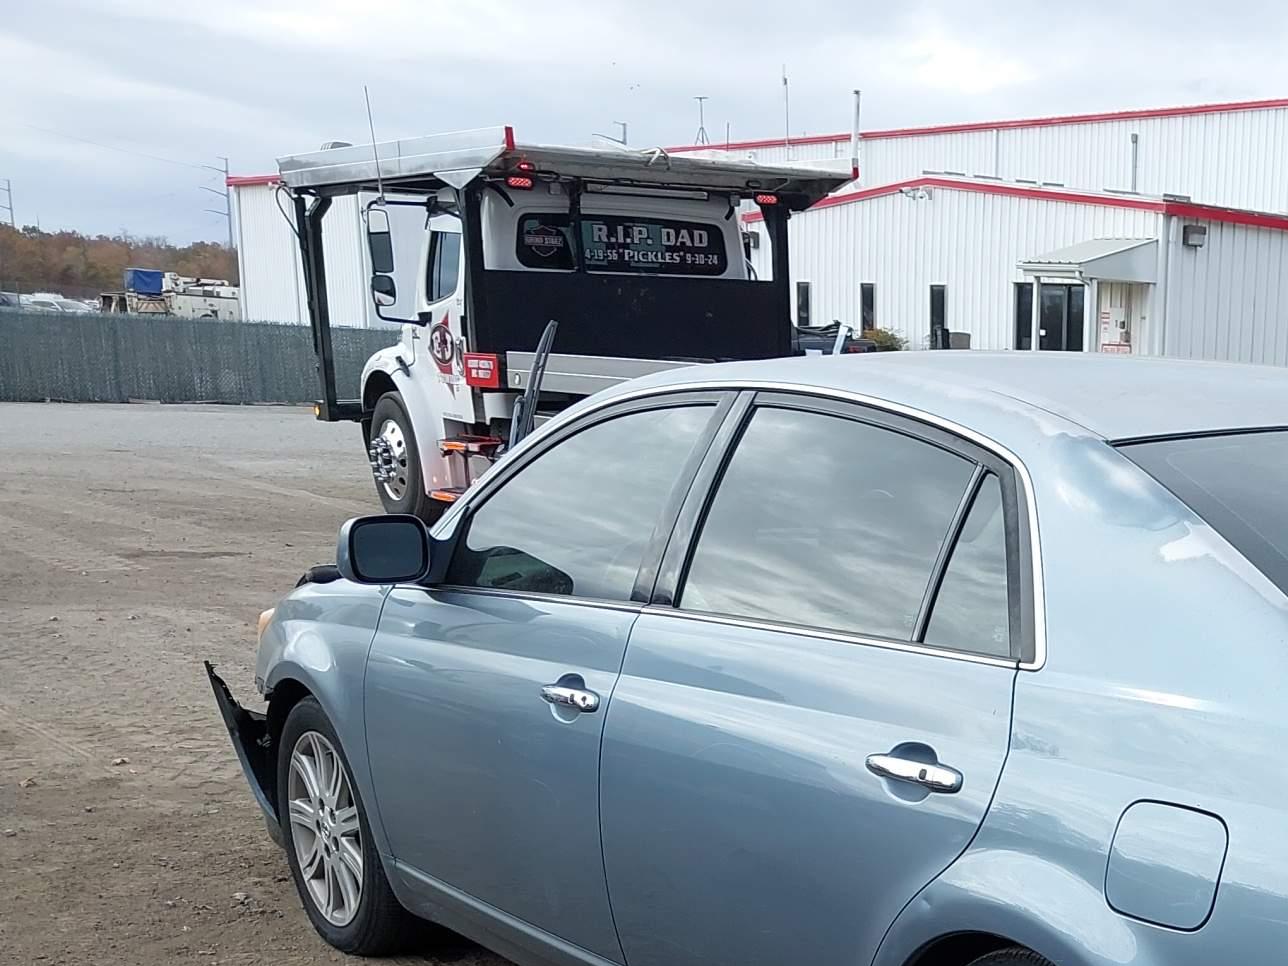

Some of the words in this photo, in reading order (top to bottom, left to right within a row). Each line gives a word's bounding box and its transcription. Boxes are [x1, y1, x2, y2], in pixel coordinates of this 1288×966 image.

[592, 224, 653, 245] R.I.P.
[661, 228, 708, 247] DAD
[584, 248, 619, 261] 4-19-56
